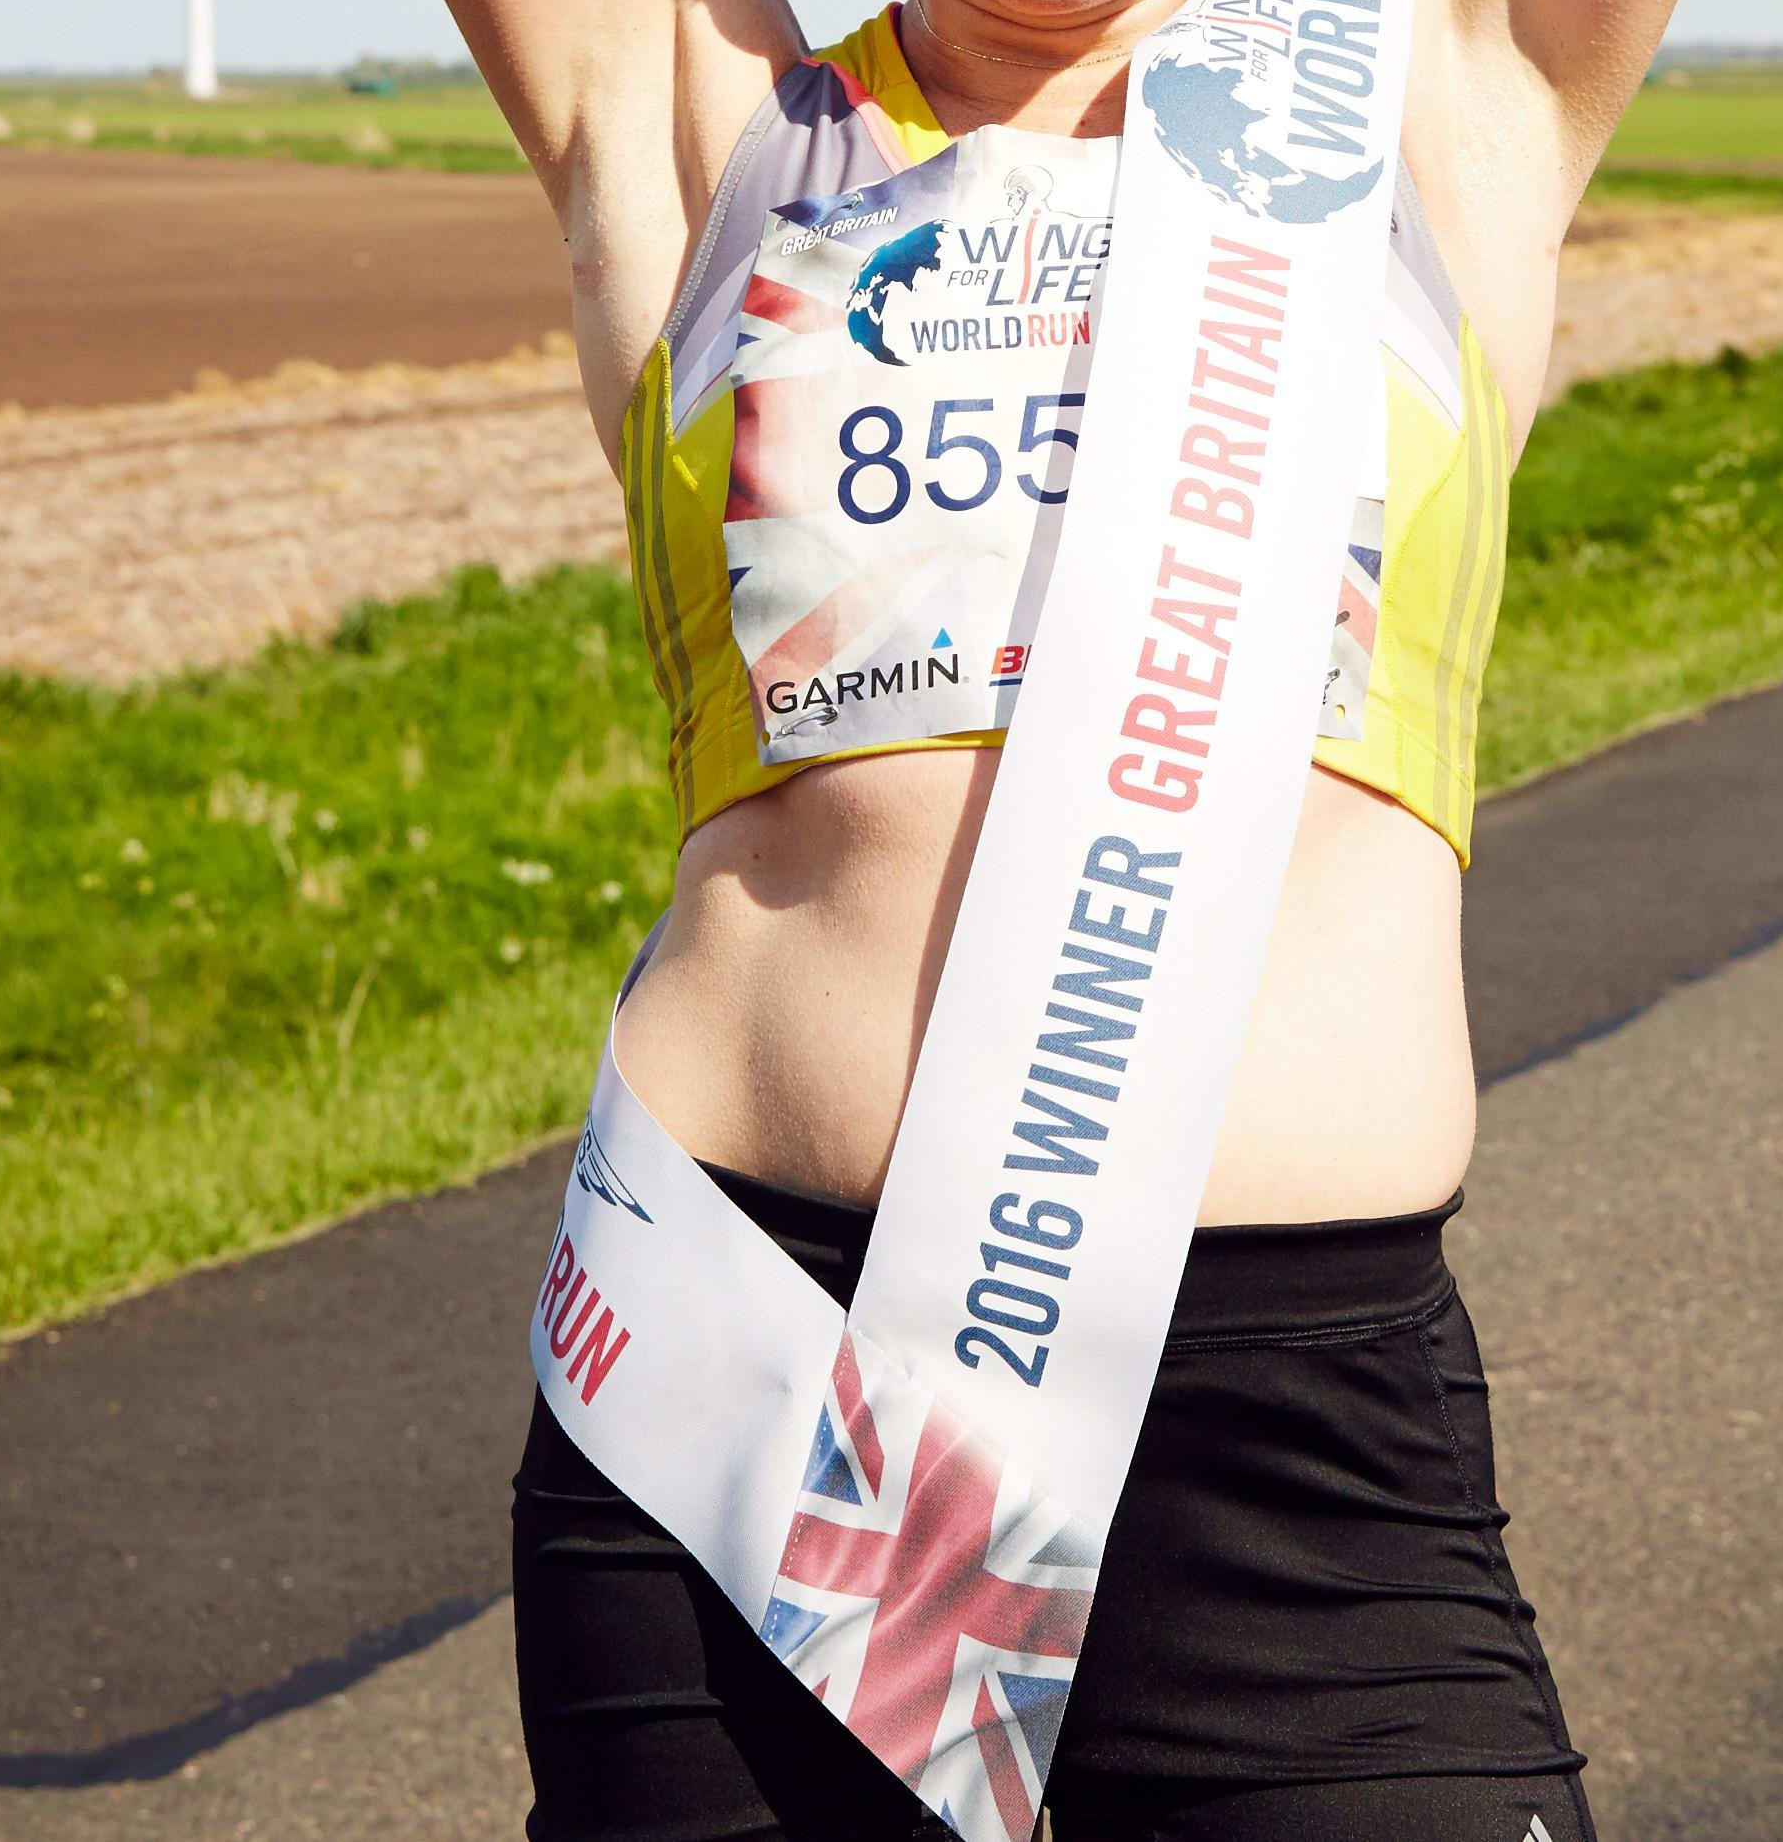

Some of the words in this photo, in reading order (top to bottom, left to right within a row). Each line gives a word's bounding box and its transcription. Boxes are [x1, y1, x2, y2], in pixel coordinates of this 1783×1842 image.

[1251, 48, 1268, 81] FOR
[781, 223, 831, 255] GREAT
[830, 207, 899, 238] BRITAIN
[958, 209, 1112, 264] WING
[947, 269, 989, 288] FOR
[985, 263, 1101, 306] LIFE
[910, 316, 1022, 353] WORLD
[1028, 311, 1091, 347] RUN
[1170, 234, 1292, 541] BRITAIN
[765, 652, 961, 714] GARMIN
[1108, 544, 1243, 813] GREAT
[1002, 834, 1183, 1177] WINNER
[540, 1232, 632, 1407] RUN
[954, 1192, 1084, 1388] 2016
